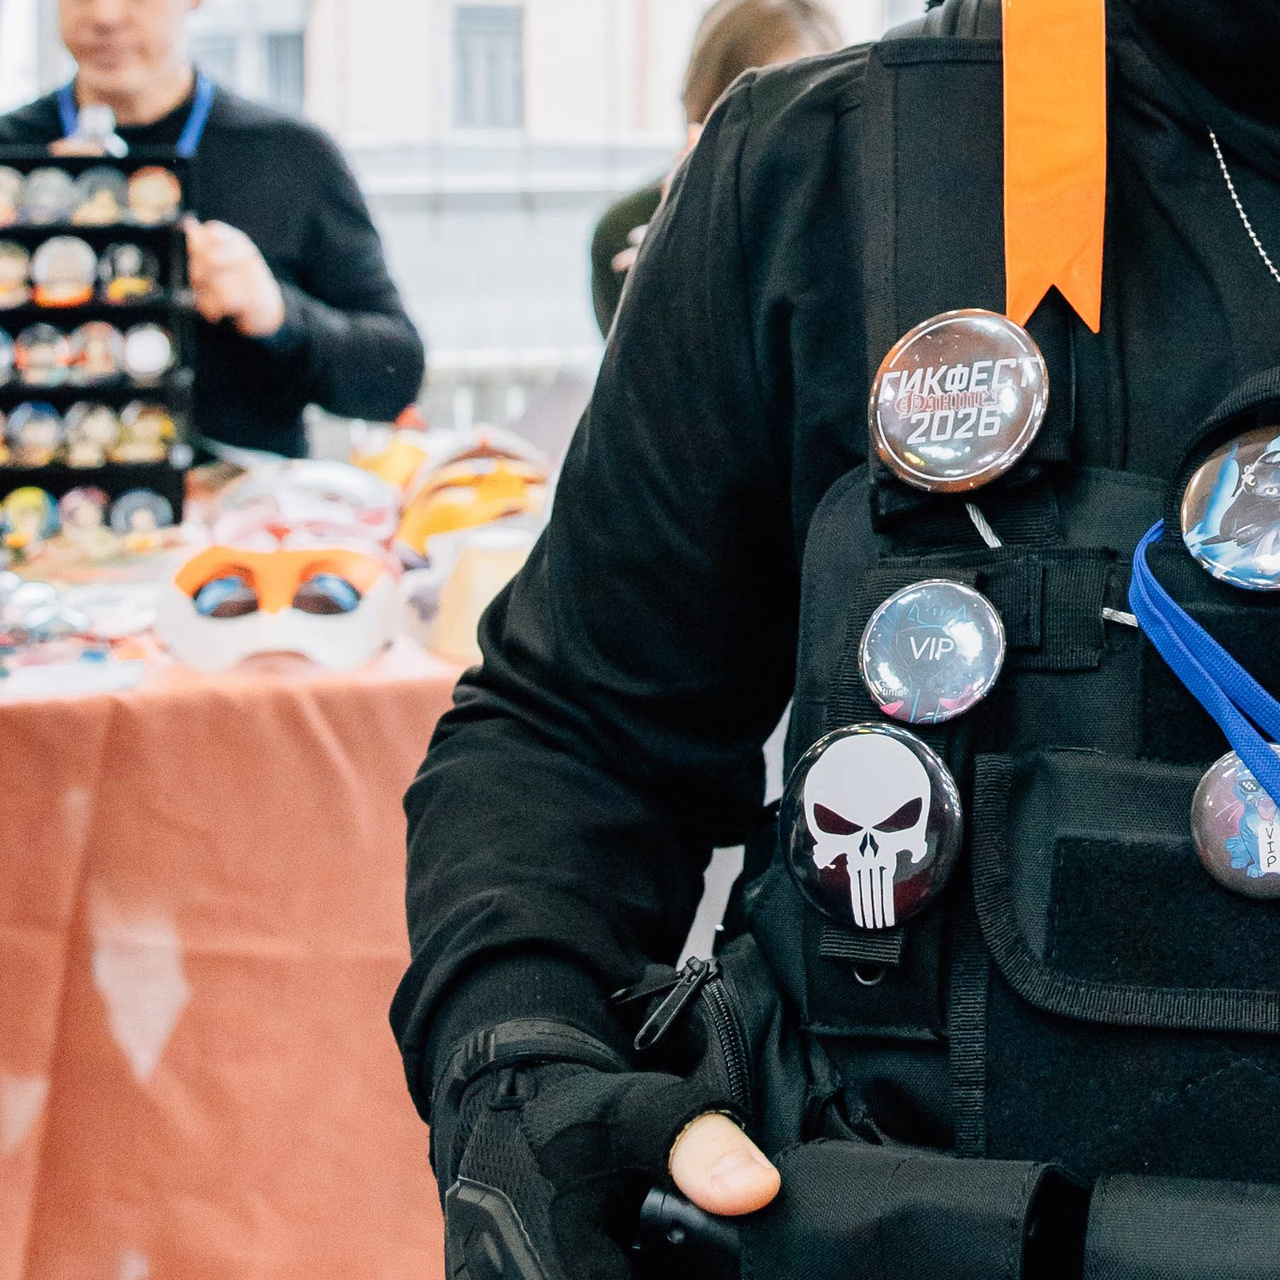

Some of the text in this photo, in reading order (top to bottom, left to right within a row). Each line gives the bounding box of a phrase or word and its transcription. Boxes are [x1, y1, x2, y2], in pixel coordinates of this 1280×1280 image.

[878, 356, 1041, 404] ГИКФЕСТ
[894, 387, 1017, 420] Фэнтез
[906, 405, 1001, 445] 2026
[910, 636, 954, 660] VIP
[1266, 827, 1277, 868] VIP
